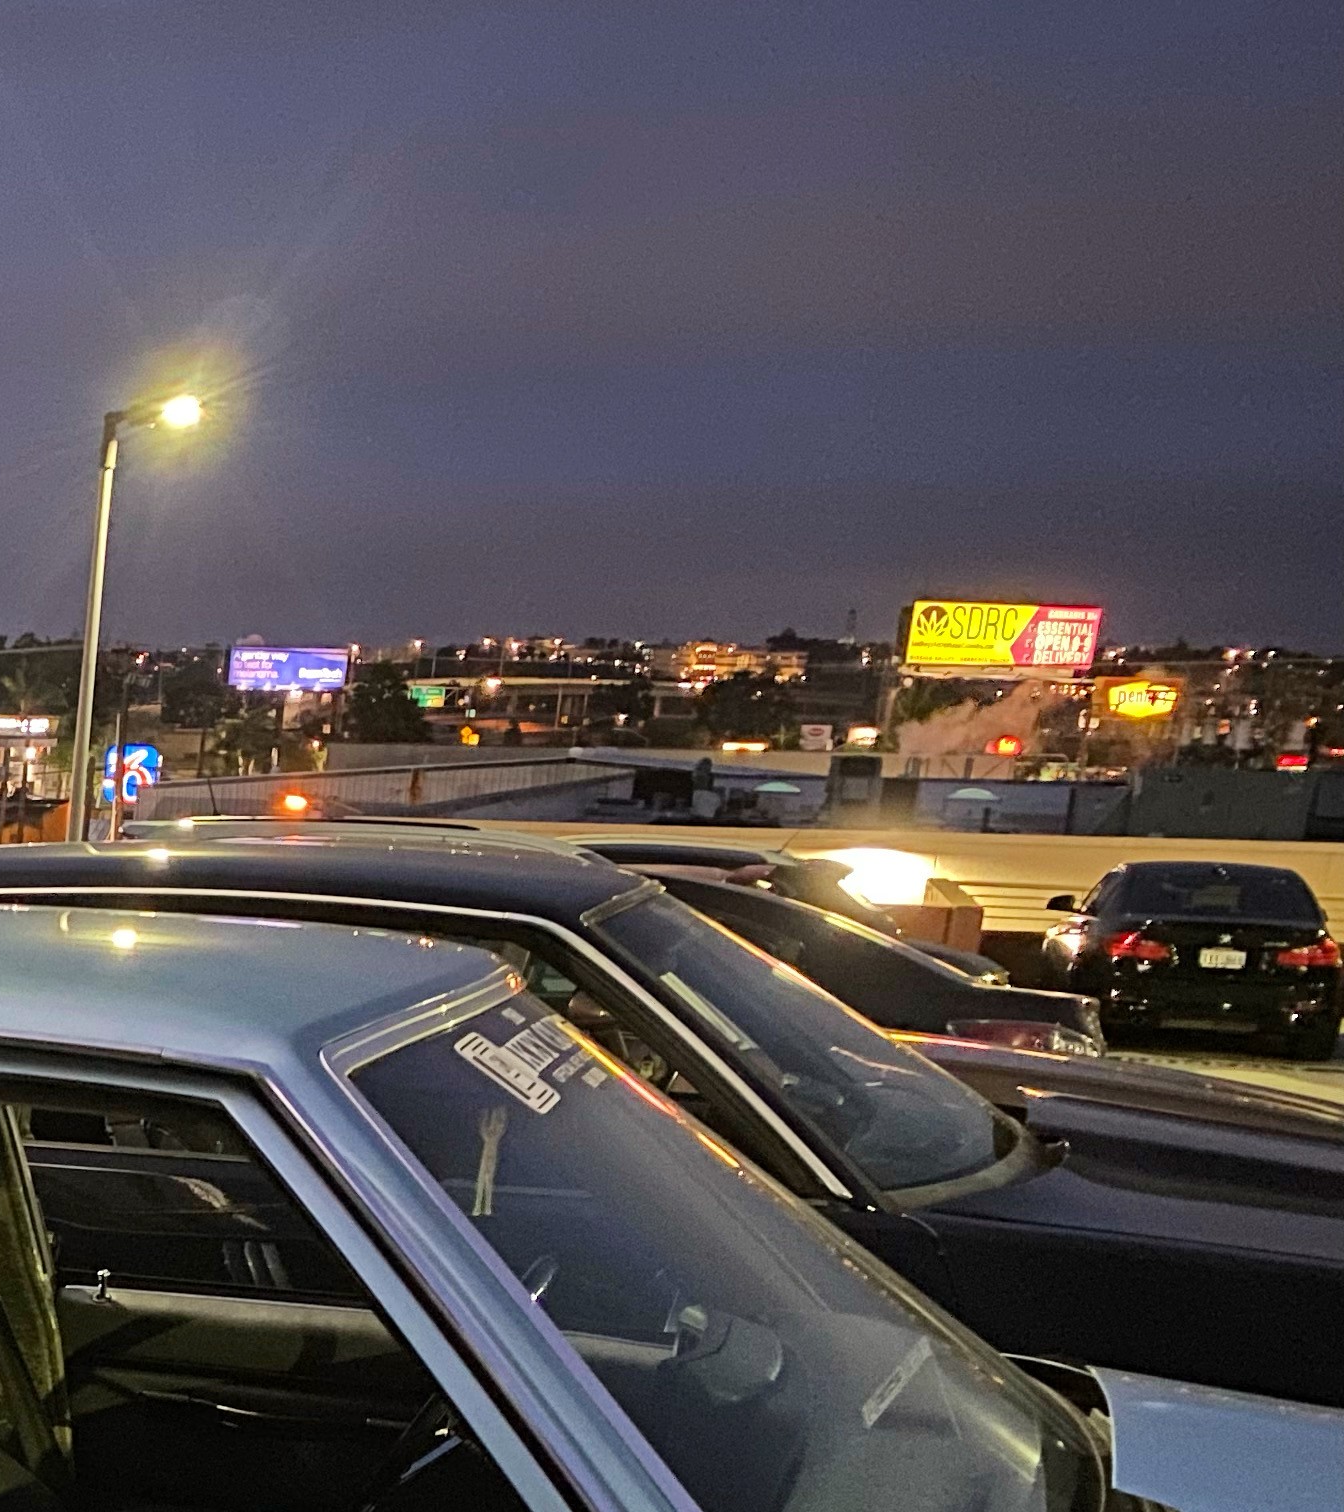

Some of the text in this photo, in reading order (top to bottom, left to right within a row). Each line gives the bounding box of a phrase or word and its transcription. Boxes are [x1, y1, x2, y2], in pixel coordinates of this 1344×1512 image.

[950, 606, 1018, 641] SDRC
[1037, 621, 1093, 636] ESSENTIAL
[1035, 634, 1071, 651] OPEN
[1033, 650, 1089, 665] DELIVERY
